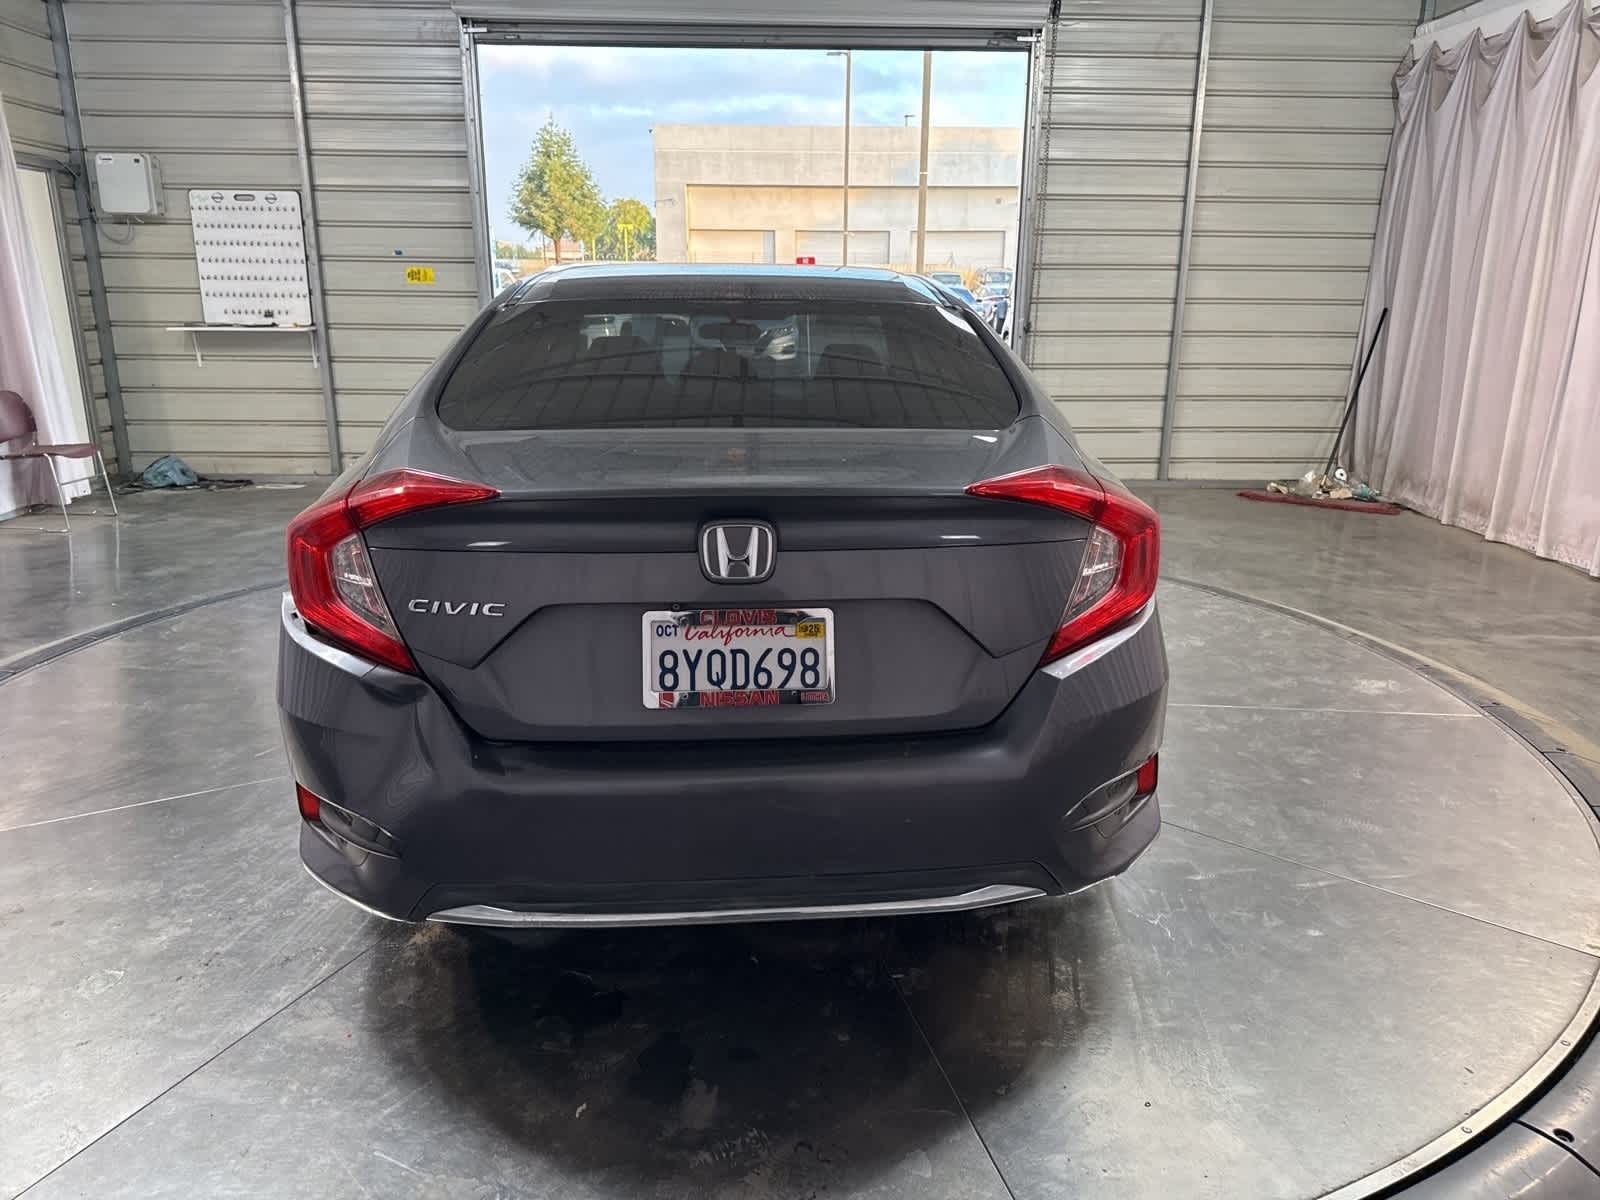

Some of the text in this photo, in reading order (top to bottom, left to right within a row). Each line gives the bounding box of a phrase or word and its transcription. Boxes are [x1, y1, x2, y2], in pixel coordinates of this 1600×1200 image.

[407, 599, 505, 617] CIVIC
[700, 609, 777, 625] CLOVIS
[656, 624, 679, 637] OCT
[684, 624, 797, 646] California
[658, 647, 820, 692] 8YQD698
[700, 691, 779, 706] NISSAN
